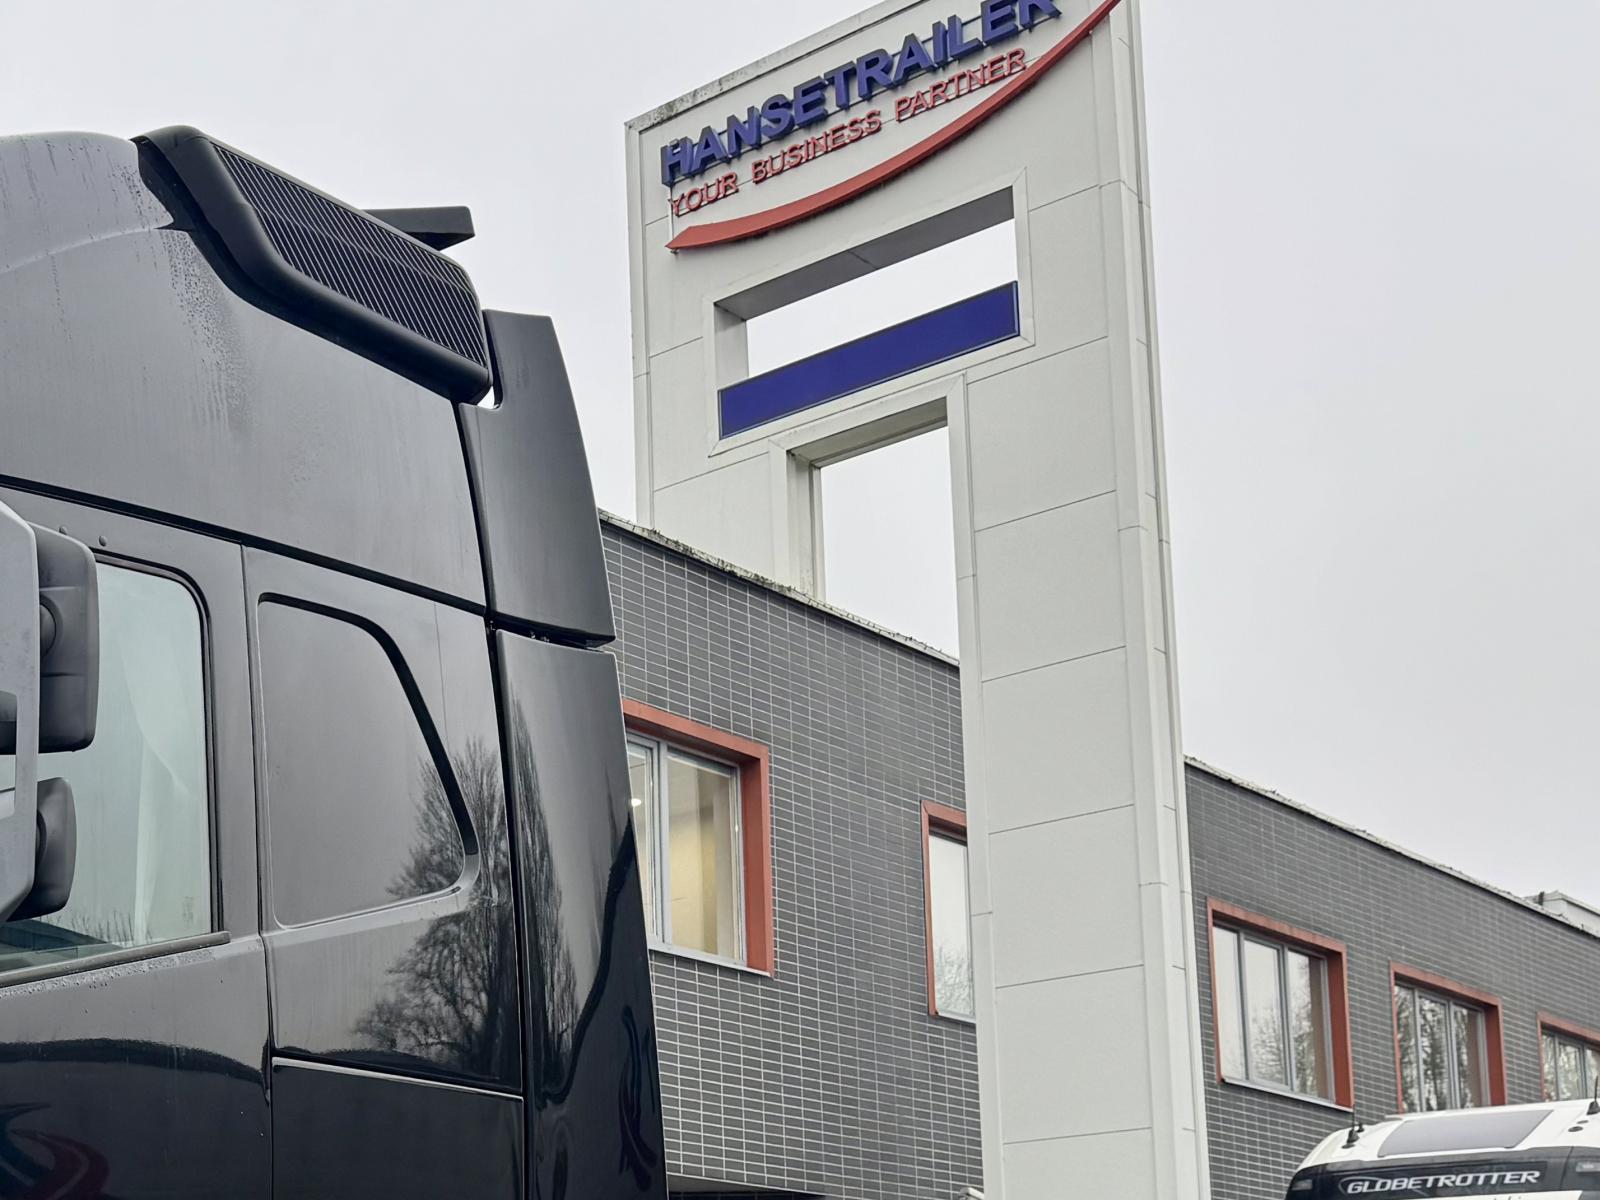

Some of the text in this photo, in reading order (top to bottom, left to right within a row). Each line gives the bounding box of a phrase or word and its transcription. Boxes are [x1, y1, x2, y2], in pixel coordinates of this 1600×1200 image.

[670, 47, 1027, 216] YOUR BUSINESS PARTNER
[1346, 1170, 1541, 1195] GLOBETROTTER
